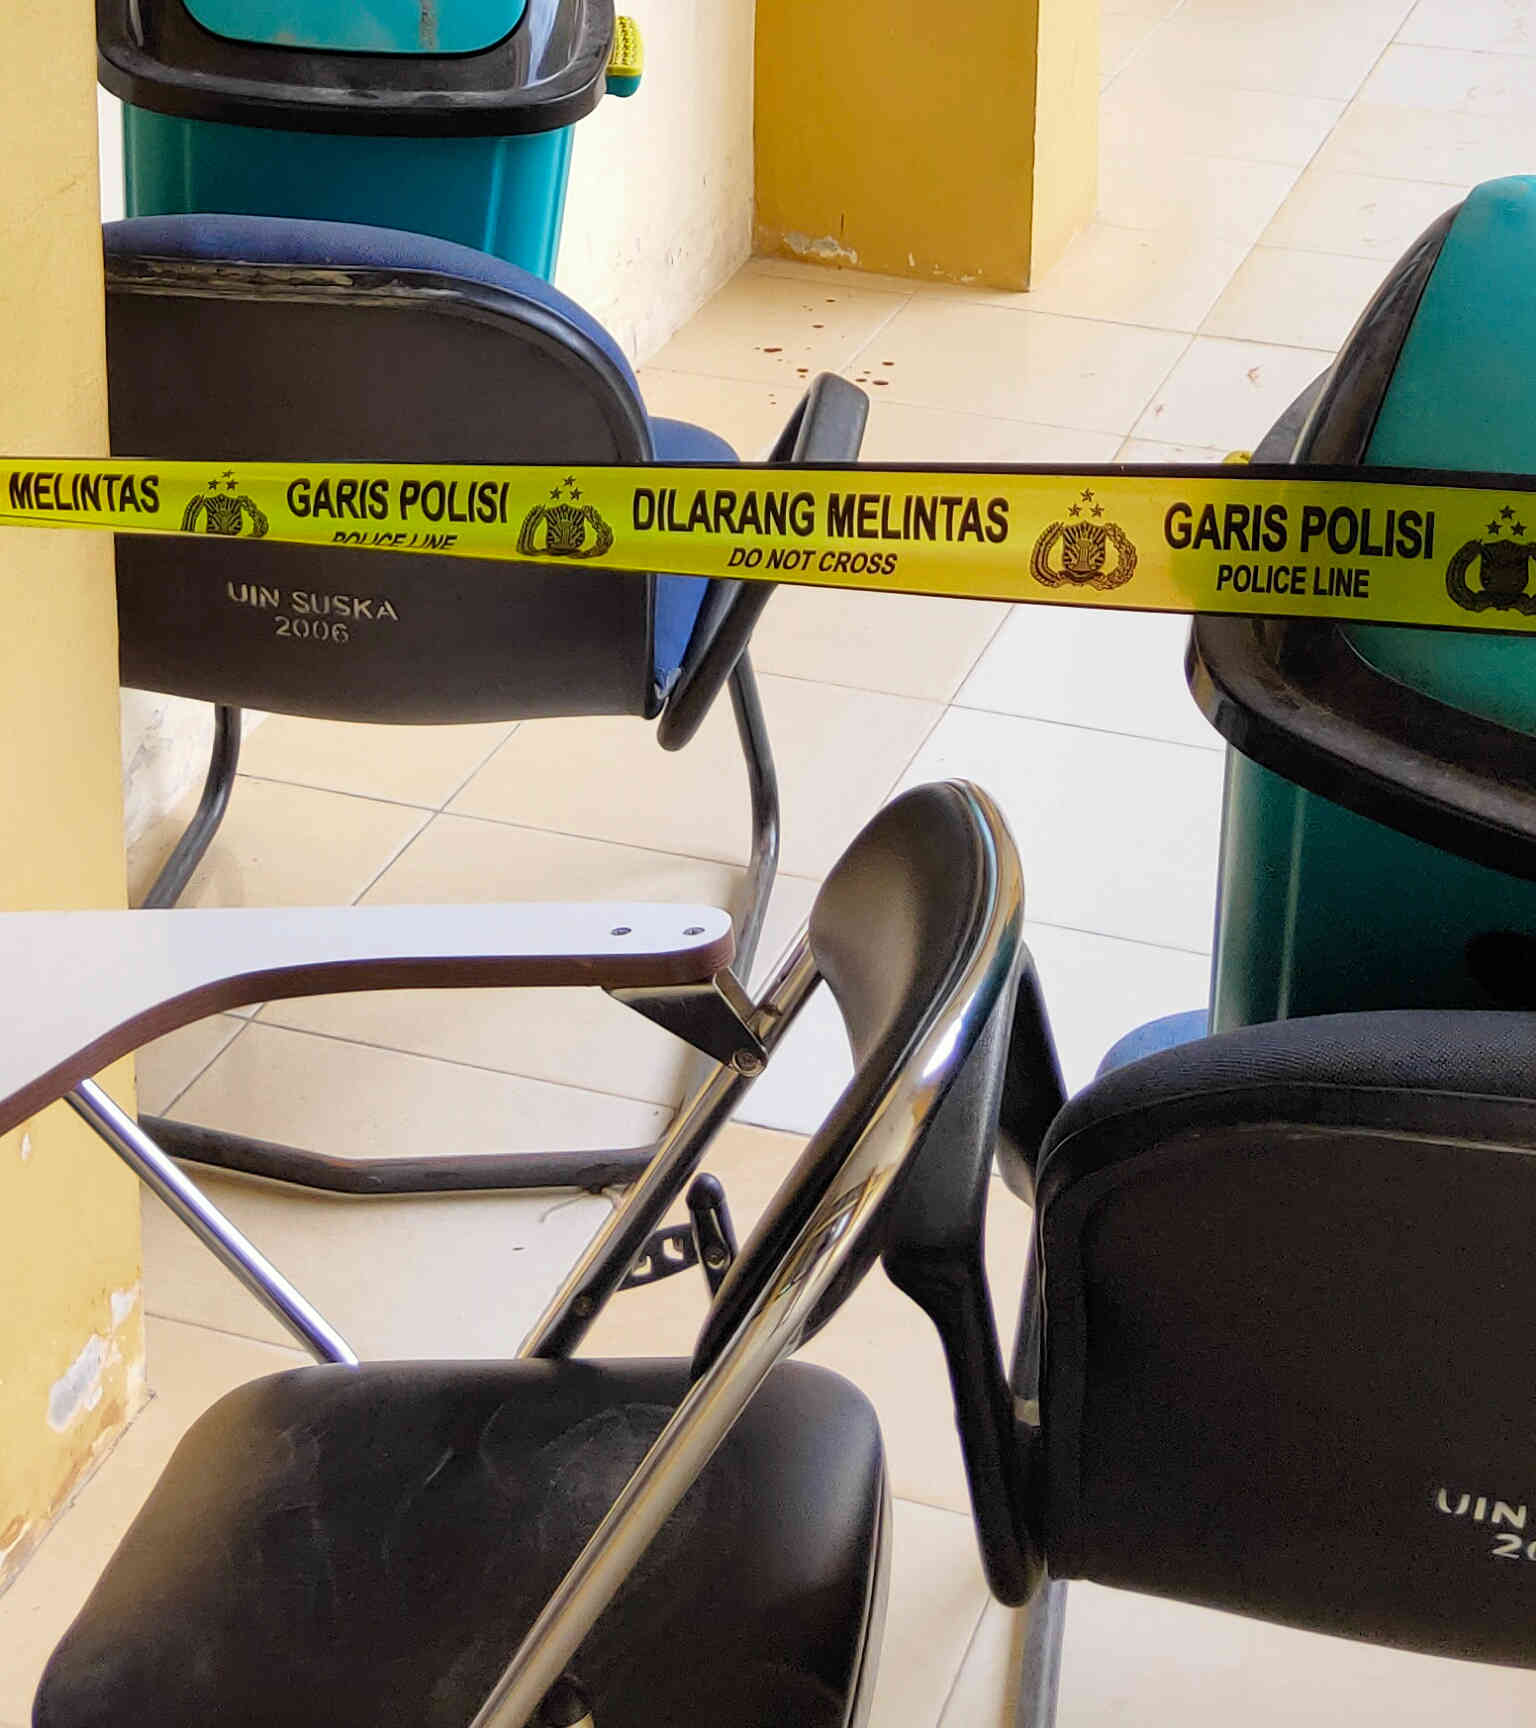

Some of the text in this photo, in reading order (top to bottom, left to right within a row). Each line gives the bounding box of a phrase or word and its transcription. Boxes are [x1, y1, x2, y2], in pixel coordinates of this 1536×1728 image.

[9, 471, 160, 513] MELINTAS
[286, 478, 511, 524] GARIS POLISI
[632, 488, 1010, 544] DILARANG MELINTAS
[1164, 502, 1436, 560] GARIS POLISI
[727, 547, 898, 576] DO NOT CROSS
[1215, 564, 1370, 598] POLICE LINE
[227, 581, 400, 622] UIN SUSKA
[274, 615, 350, 644] 2006
[1434, 1487, 1528, 1529] UIN
